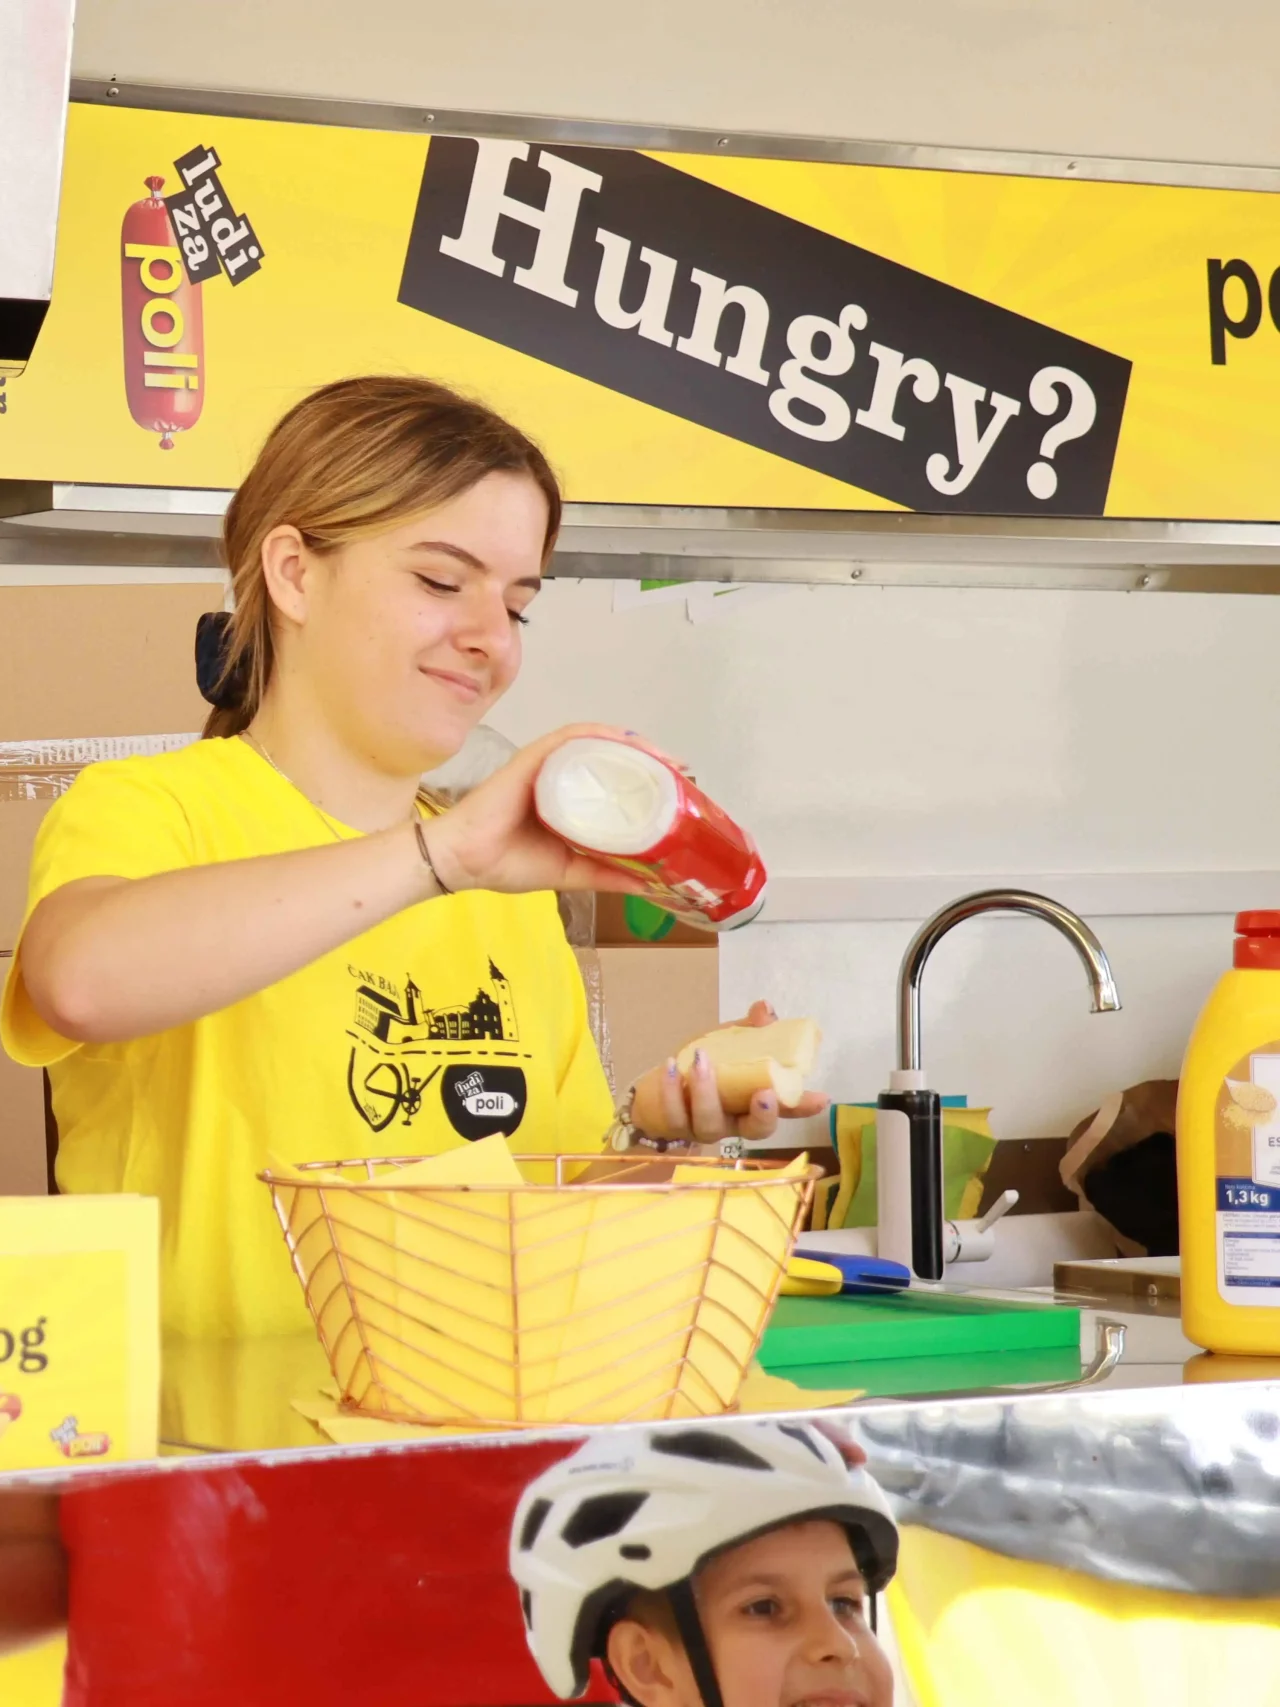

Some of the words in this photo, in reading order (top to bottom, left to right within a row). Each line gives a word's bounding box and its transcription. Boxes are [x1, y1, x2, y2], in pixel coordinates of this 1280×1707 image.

[171, 202, 209, 272] za
[181, 151, 260, 277] ludi
[124, 243, 198, 390] poli
[438, 138, 1097, 500] Hungry?
[1206, 257, 1280, 366] p
[457, 1073, 481, 1094] ludi
[467, 1087, 481, 1097] za
[475, 1095, 504, 1113] poli
[1225, 1190, 1248, 1205] 1,3
[1250, 1190, 1269, 1207] kg
